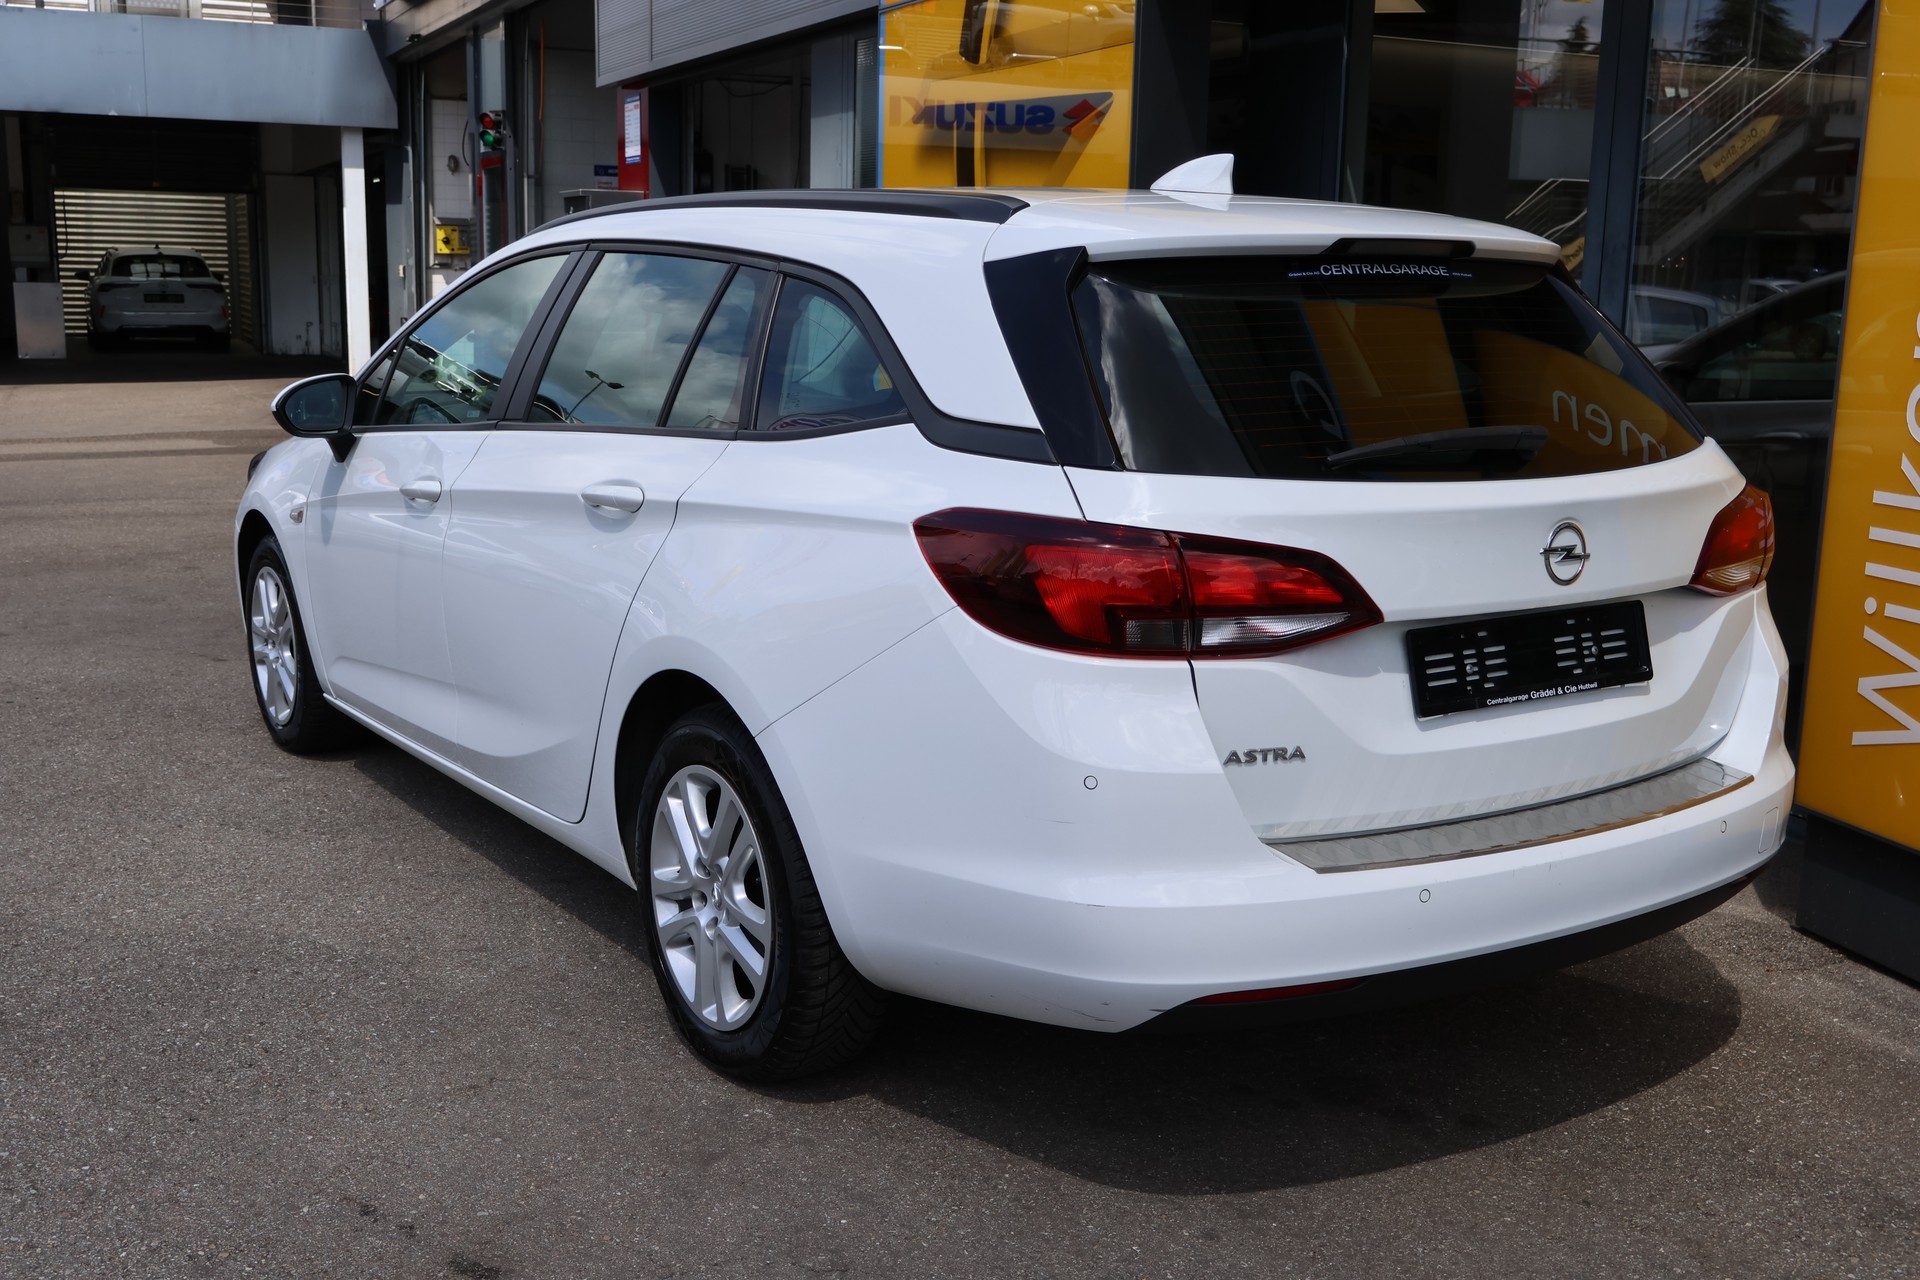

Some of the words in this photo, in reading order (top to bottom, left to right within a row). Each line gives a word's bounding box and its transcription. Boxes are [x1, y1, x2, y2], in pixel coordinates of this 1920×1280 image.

[1320, 263, 1450, 276] CENTRALGARAGE
[1486, 693, 1529, 706] Centralgarage
[1530, 687, 1556, 699] Grädel
[1557, 686, 1563, 695] &
[1564, 684, 1577, 693] Cie
[1578, 681, 1598, 691] Huttwil
[1223, 745, 1306, 766] ASTRA
